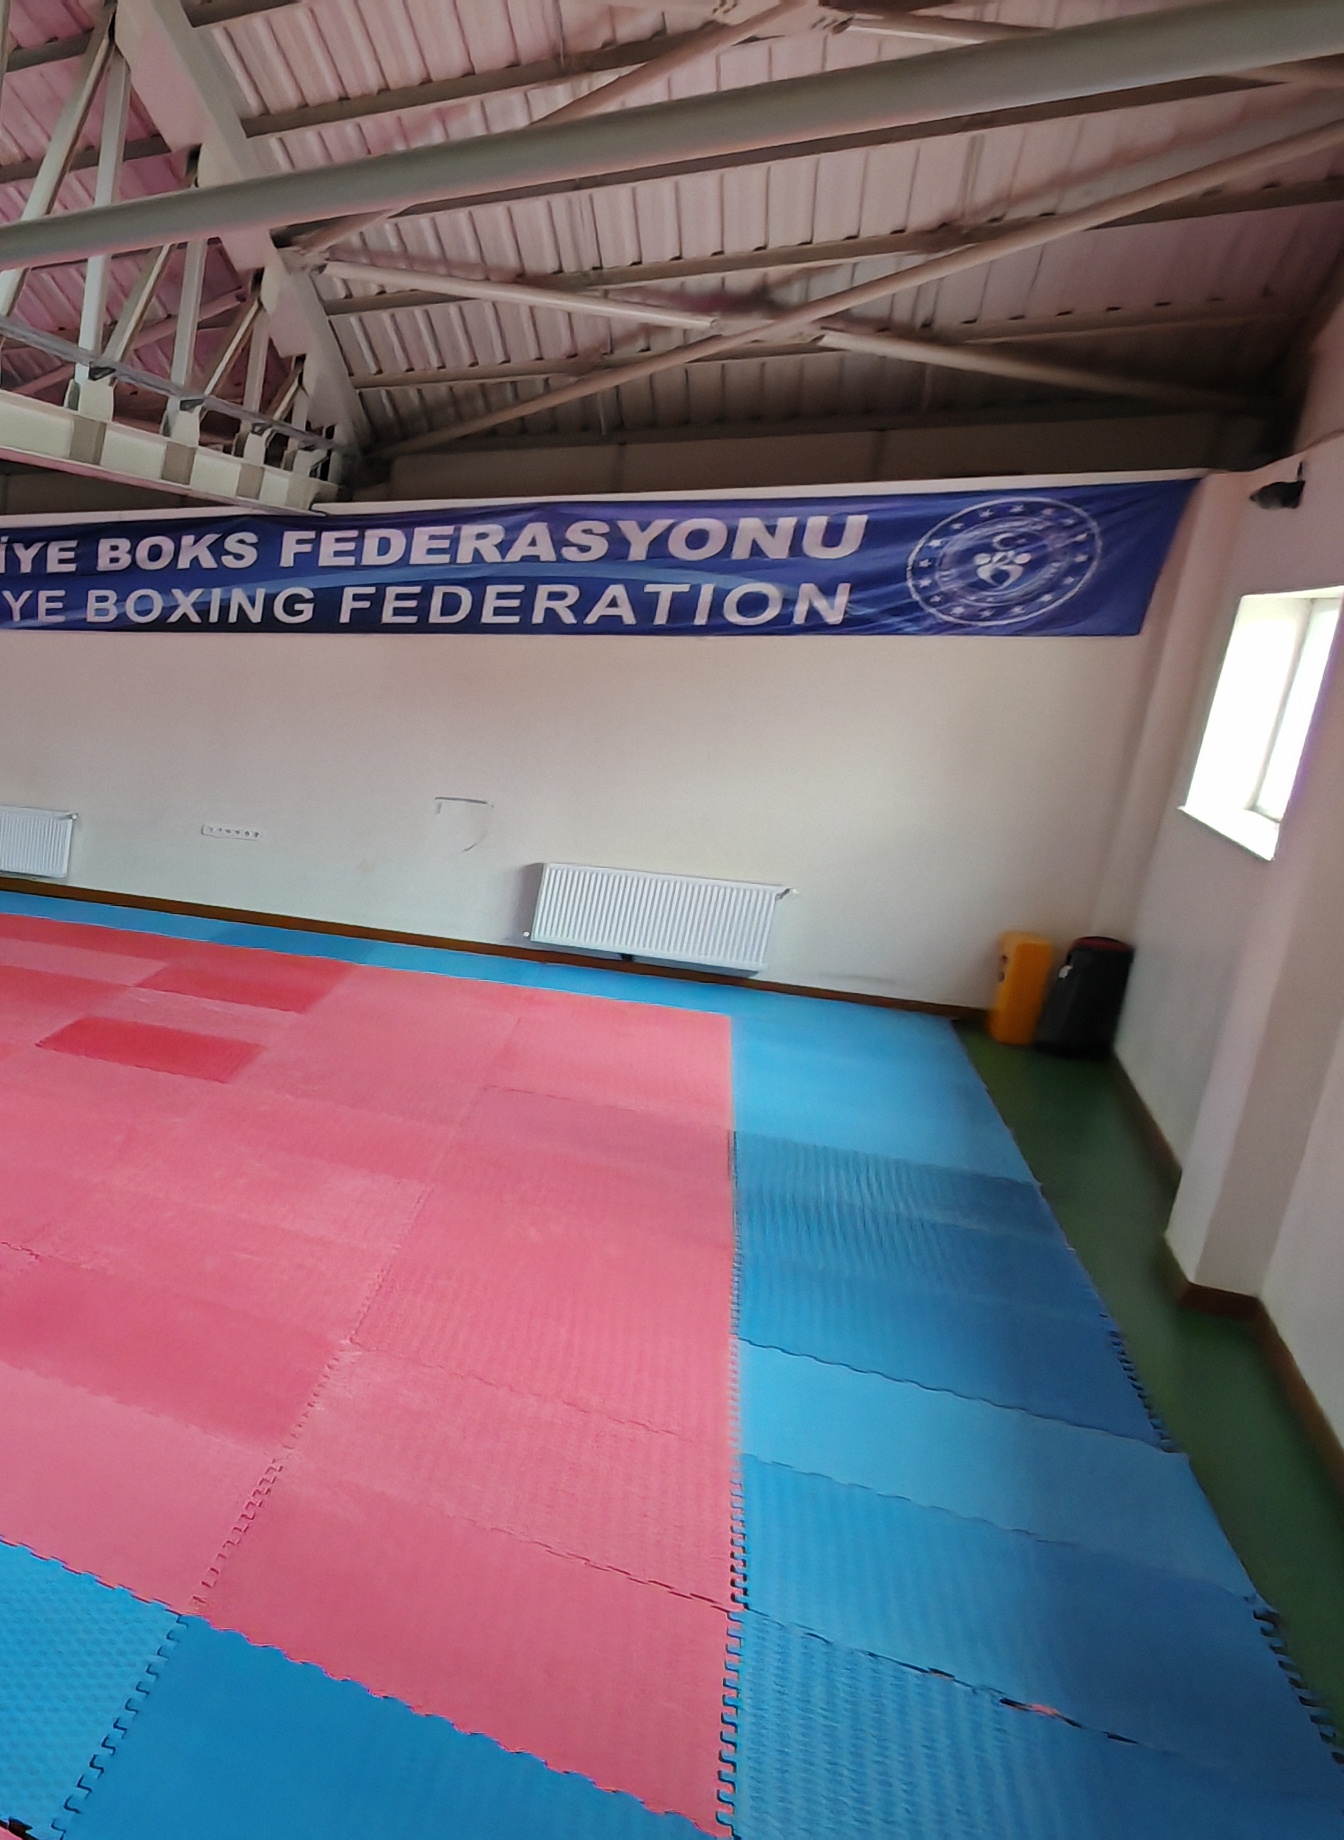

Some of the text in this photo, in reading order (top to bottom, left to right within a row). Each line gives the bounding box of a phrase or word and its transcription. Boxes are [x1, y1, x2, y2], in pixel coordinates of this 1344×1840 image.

[96, 531, 259, 572] BOKS
[279, 514, 869, 568] FEDERASYONU
[86, 587, 315, 624] BOXING
[339, 581, 852, 626] FEDERATION
